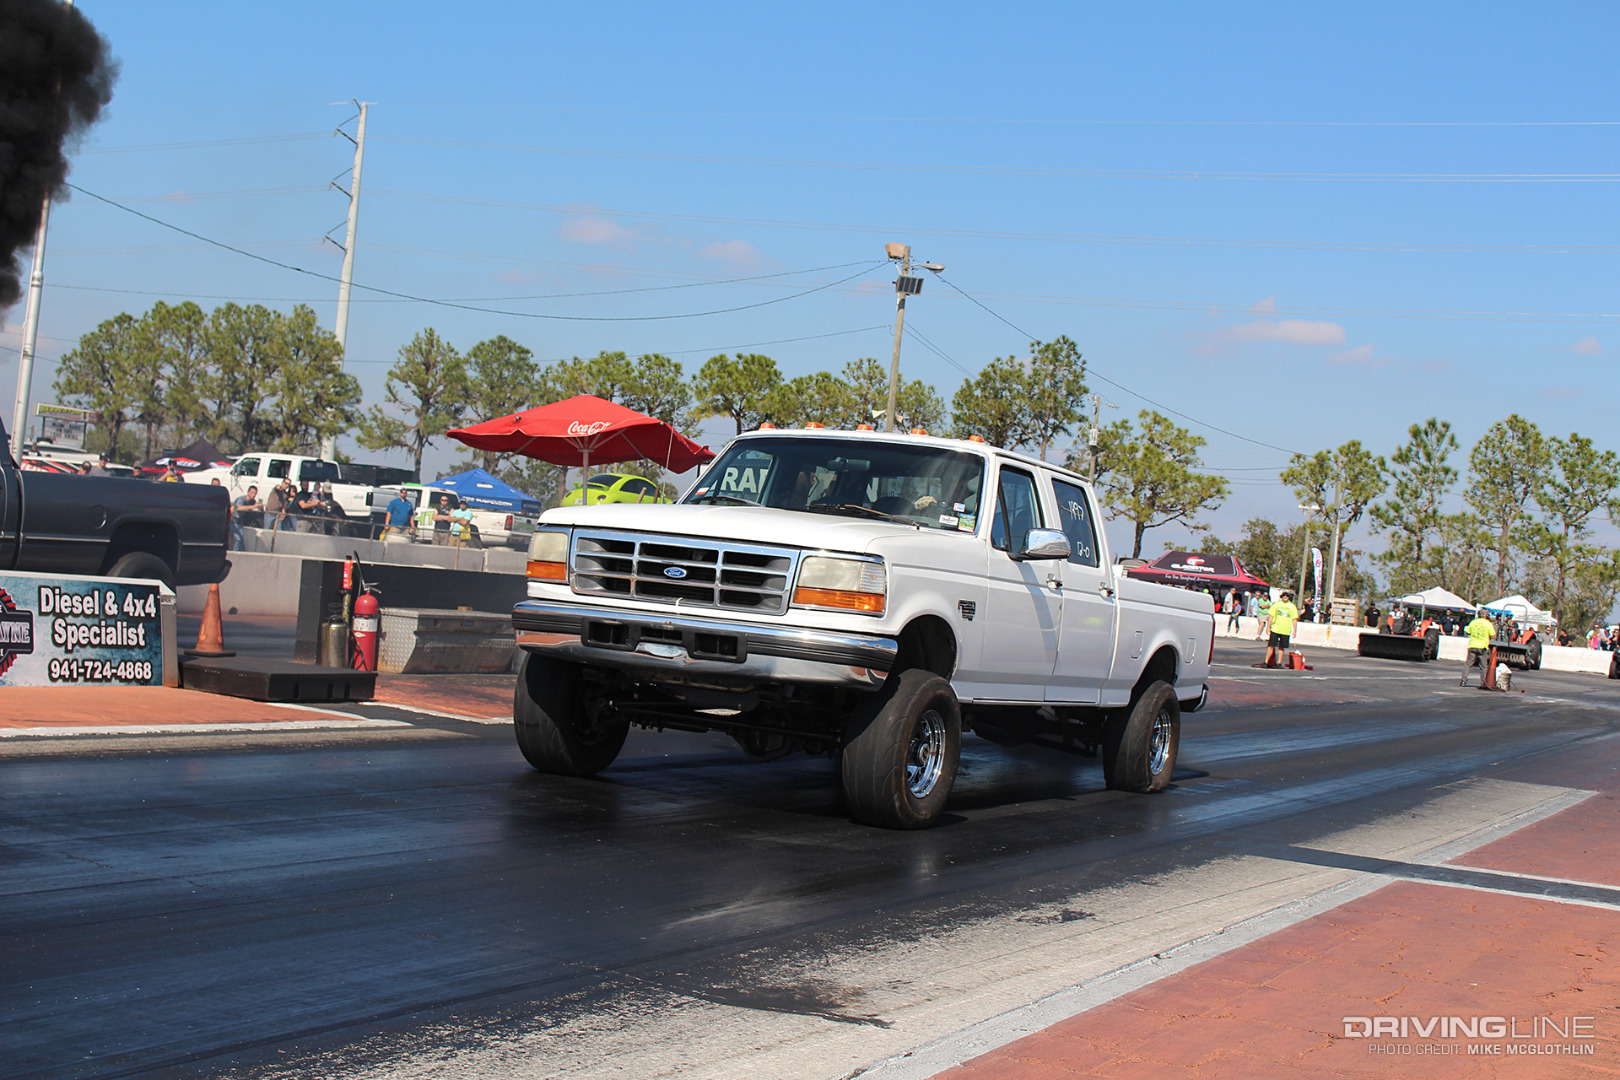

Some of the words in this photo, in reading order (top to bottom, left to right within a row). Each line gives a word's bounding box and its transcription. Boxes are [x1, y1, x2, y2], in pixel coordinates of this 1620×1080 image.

[39, 587, 100, 616] Diesel
[104, 590, 119, 616] &
[123, 592, 157, 618] 4x4
[53, 618, 146, 651] Specialist
[50, 659, 152, 681] 941-724-4868
